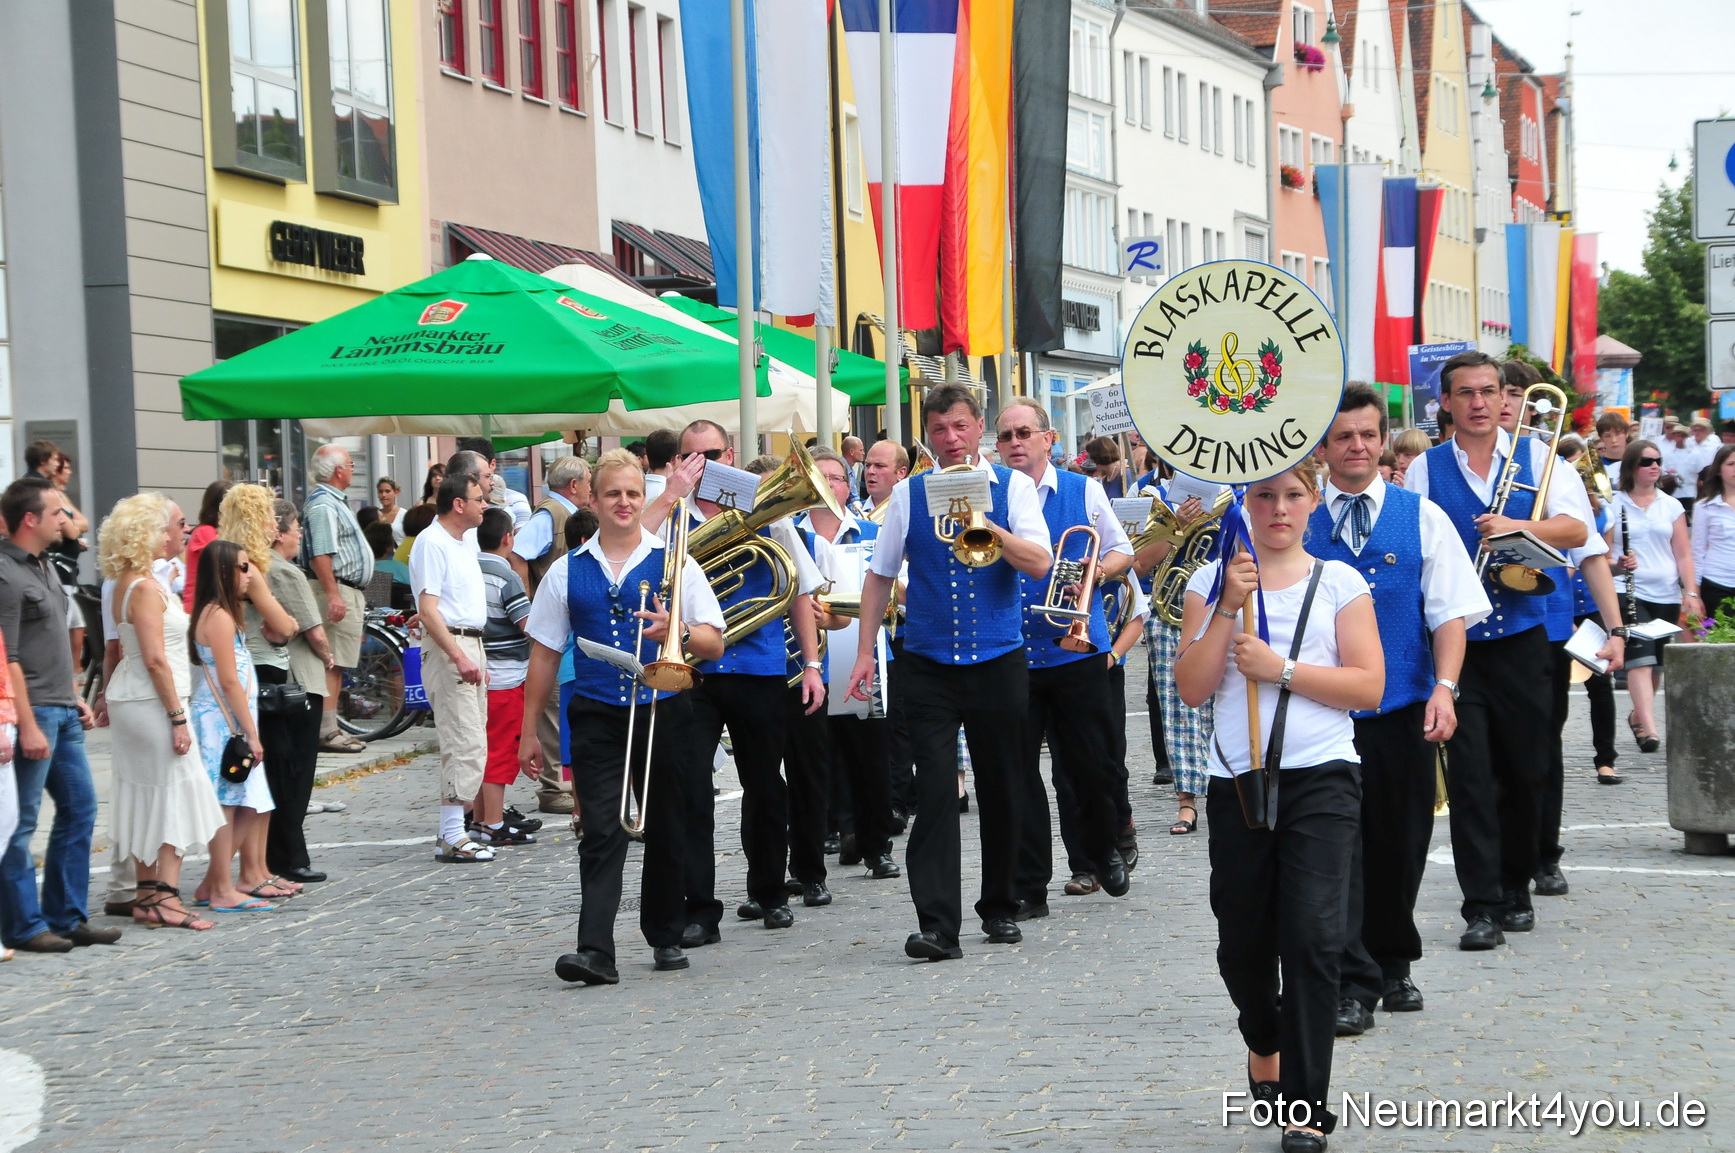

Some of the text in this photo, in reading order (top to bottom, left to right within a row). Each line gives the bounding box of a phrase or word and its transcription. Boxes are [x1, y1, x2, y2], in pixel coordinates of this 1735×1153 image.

[317, 228, 365, 275] WEBER
[1134, 268, 1331, 360] BLASKAPELLE
[364, 330, 491, 346] Neumarkter
[329, 340, 507, 359] Lammsbräu
[1420, 344, 1465, 353] Geistesblitze
[1104, 399, 1125, 409] Jahr
[1095, 409, 1129, 422] Schachk
[1101, 421, 1133, 432] Neumar
[1163, 418, 1308, 474] DEINING
